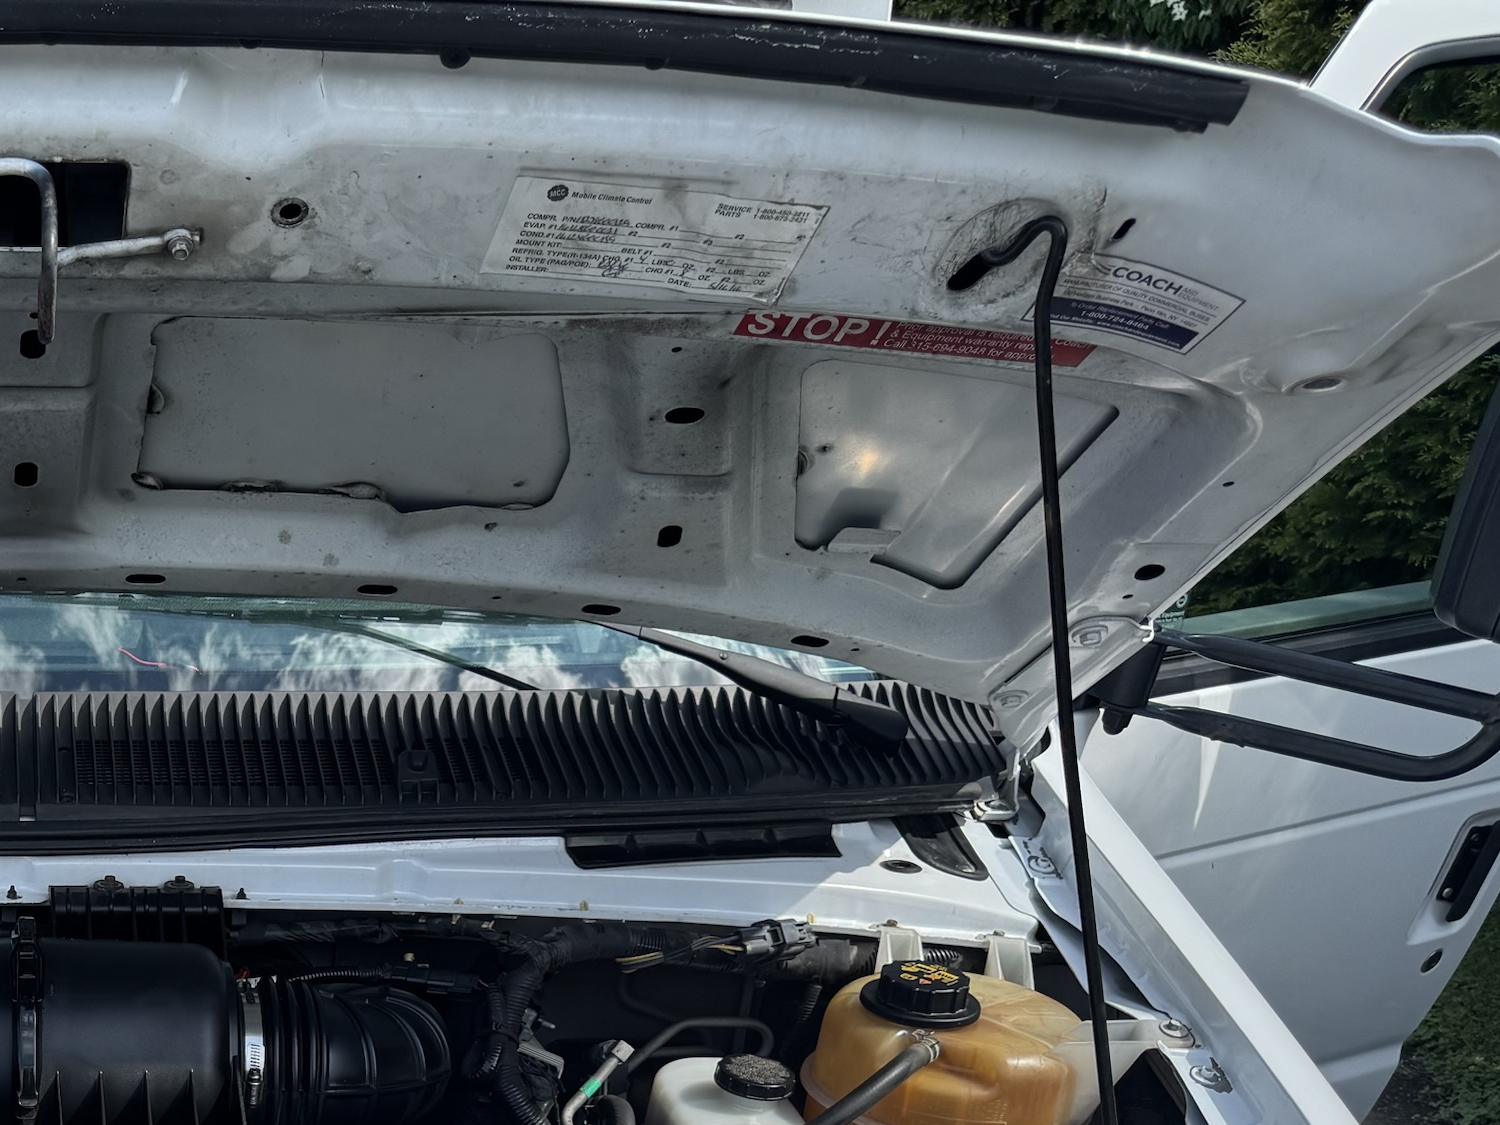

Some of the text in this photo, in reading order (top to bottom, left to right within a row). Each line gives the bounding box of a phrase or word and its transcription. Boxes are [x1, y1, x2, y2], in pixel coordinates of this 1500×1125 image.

[571, 191, 652, 204] Mobile Climate Control
[713, 209, 742, 218] PARTS
[716, 203, 753, 213] SERVICE
[514, 238, 545, 247] MOUNT
[619, 247, 643, 255] BELT
[523, 256, 546, 264] TYPE
[504, 263, 694, 287] INSTALLER: DATE:
[1112, 266, 1184, 296] COACH
[1182, 287, 1198, 296] AND
[1122, 288, 1148, 299] QUALITY
[1148, 297, 1188, 313] COMMERCIAL
[1189, 310, 1211, 322] BUSES
[1178, 293, 1218, 311] EQUIPMENT
[890, 330, 1013, 350] & Equipment warranty
[926, 325, 974, 337] approval
[976, 328, 987, 337] is
[988, 329, 1035, 342] required
[884, 338, 906, 349] Call
[988, 349, 1003, 358] for
